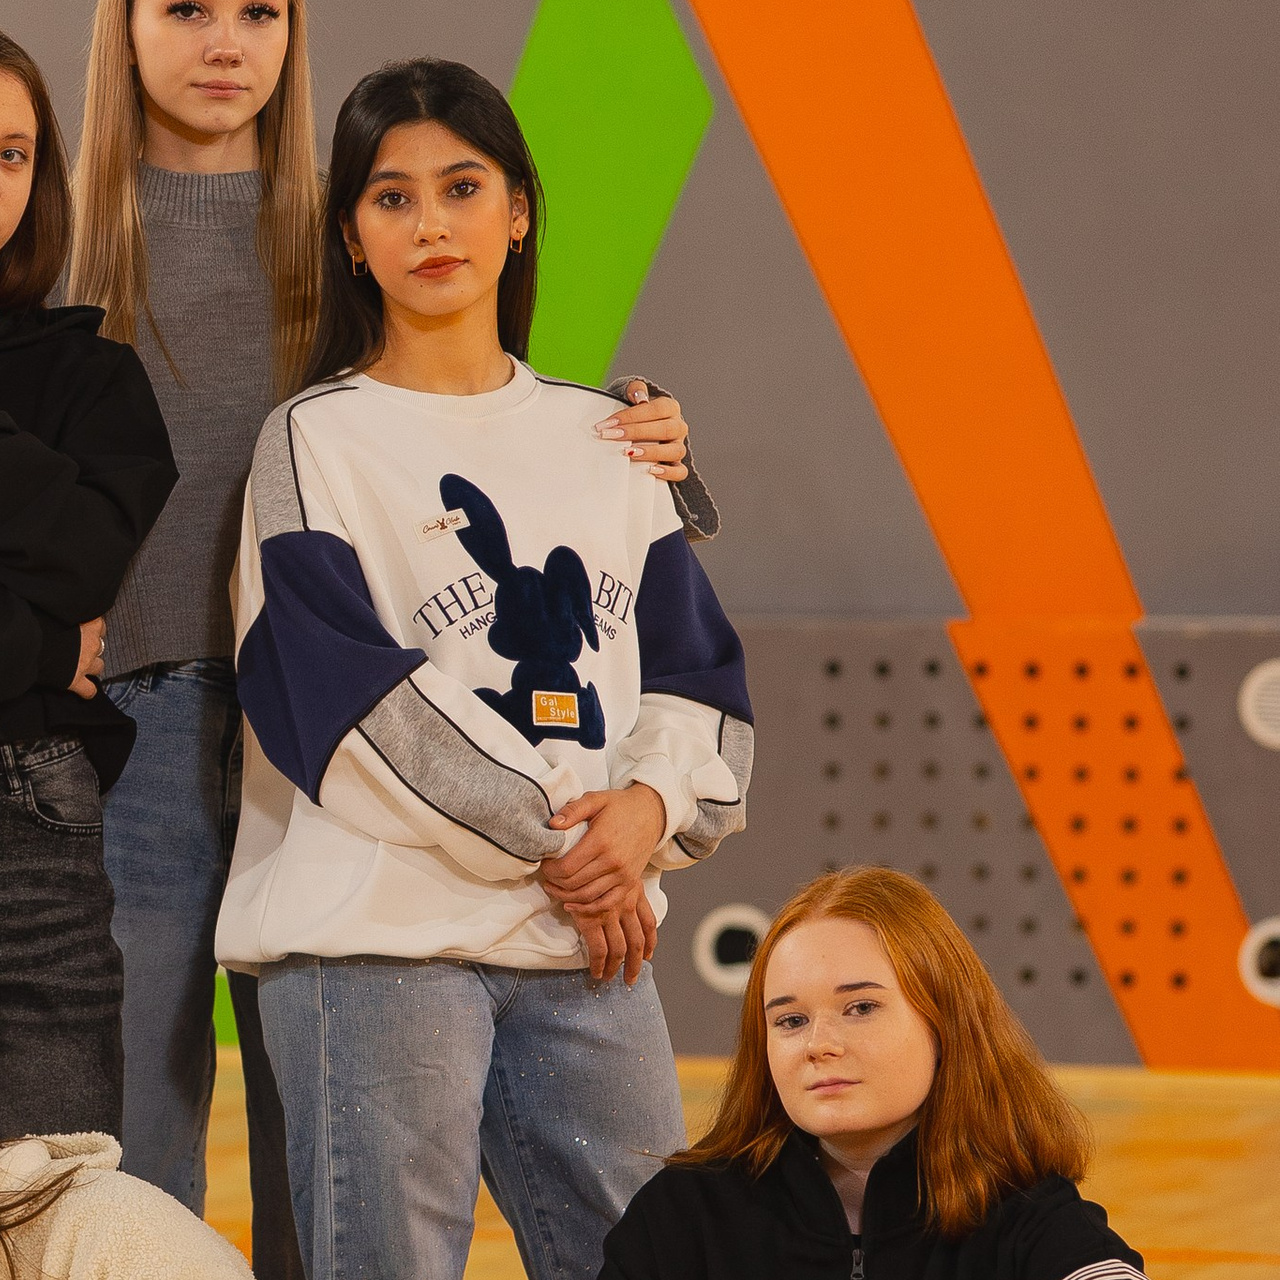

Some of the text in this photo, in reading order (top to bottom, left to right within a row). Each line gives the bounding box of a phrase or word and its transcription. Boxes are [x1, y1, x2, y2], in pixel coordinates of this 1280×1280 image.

[413, 572, 493, 640] THE
[540, 696, 558, 706] Gal
[550, 707, 575, 720] Style
